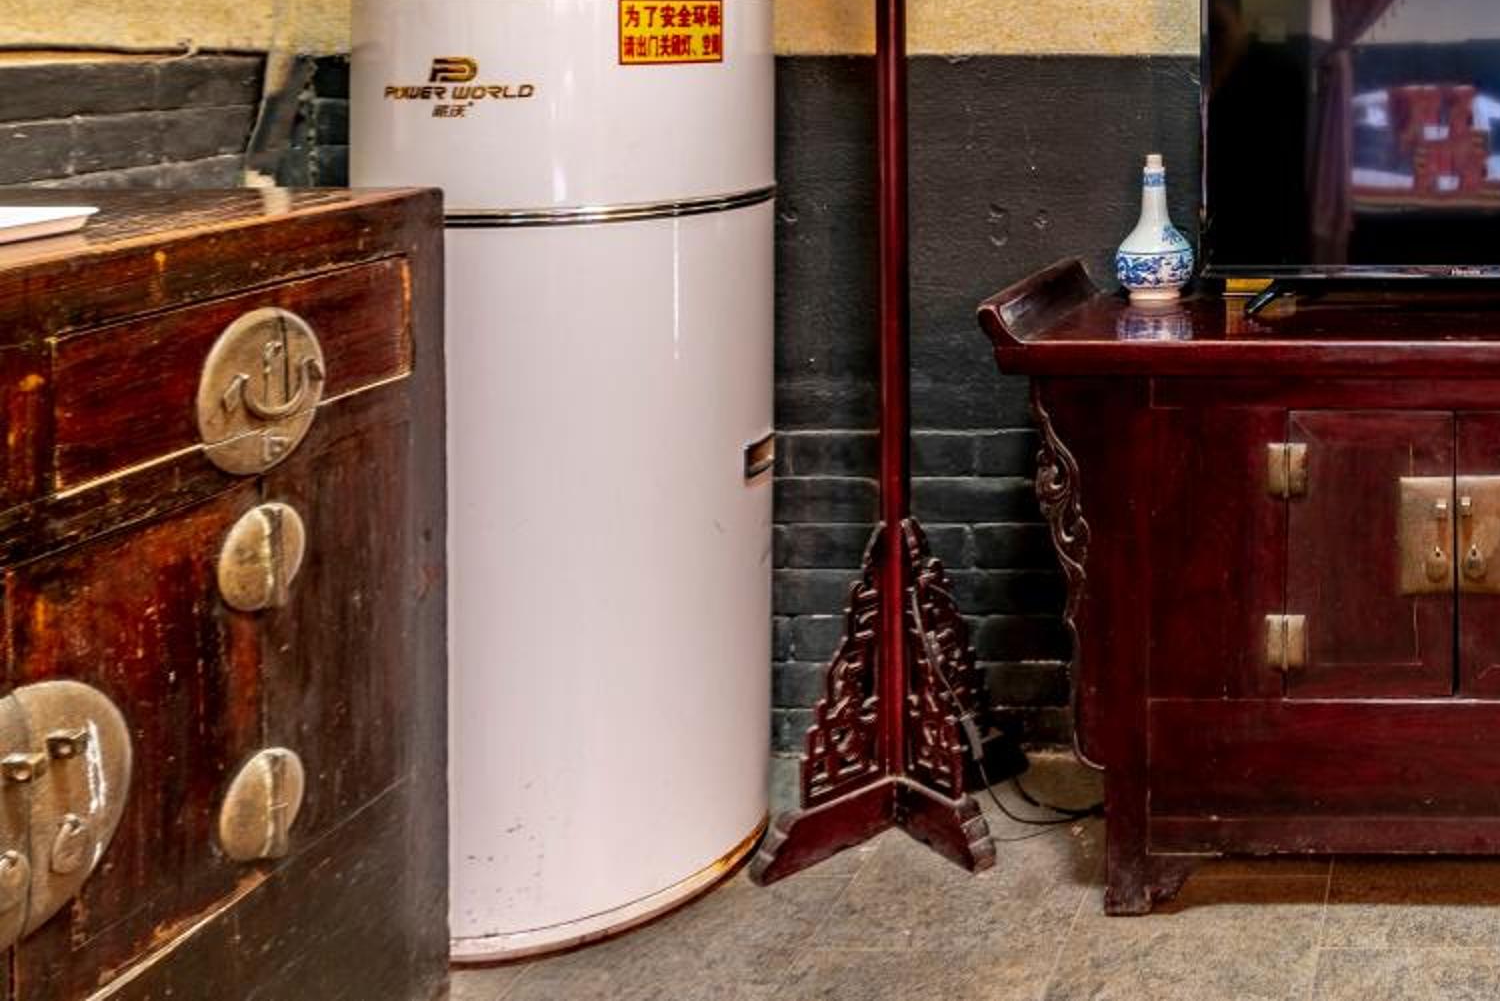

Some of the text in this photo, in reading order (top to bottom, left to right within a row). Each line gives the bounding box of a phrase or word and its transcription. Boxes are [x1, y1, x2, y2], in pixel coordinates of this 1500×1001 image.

[625, 4, 720, 27] 为了安全环保
[384, 84, 535, 100] POWER WORLD
